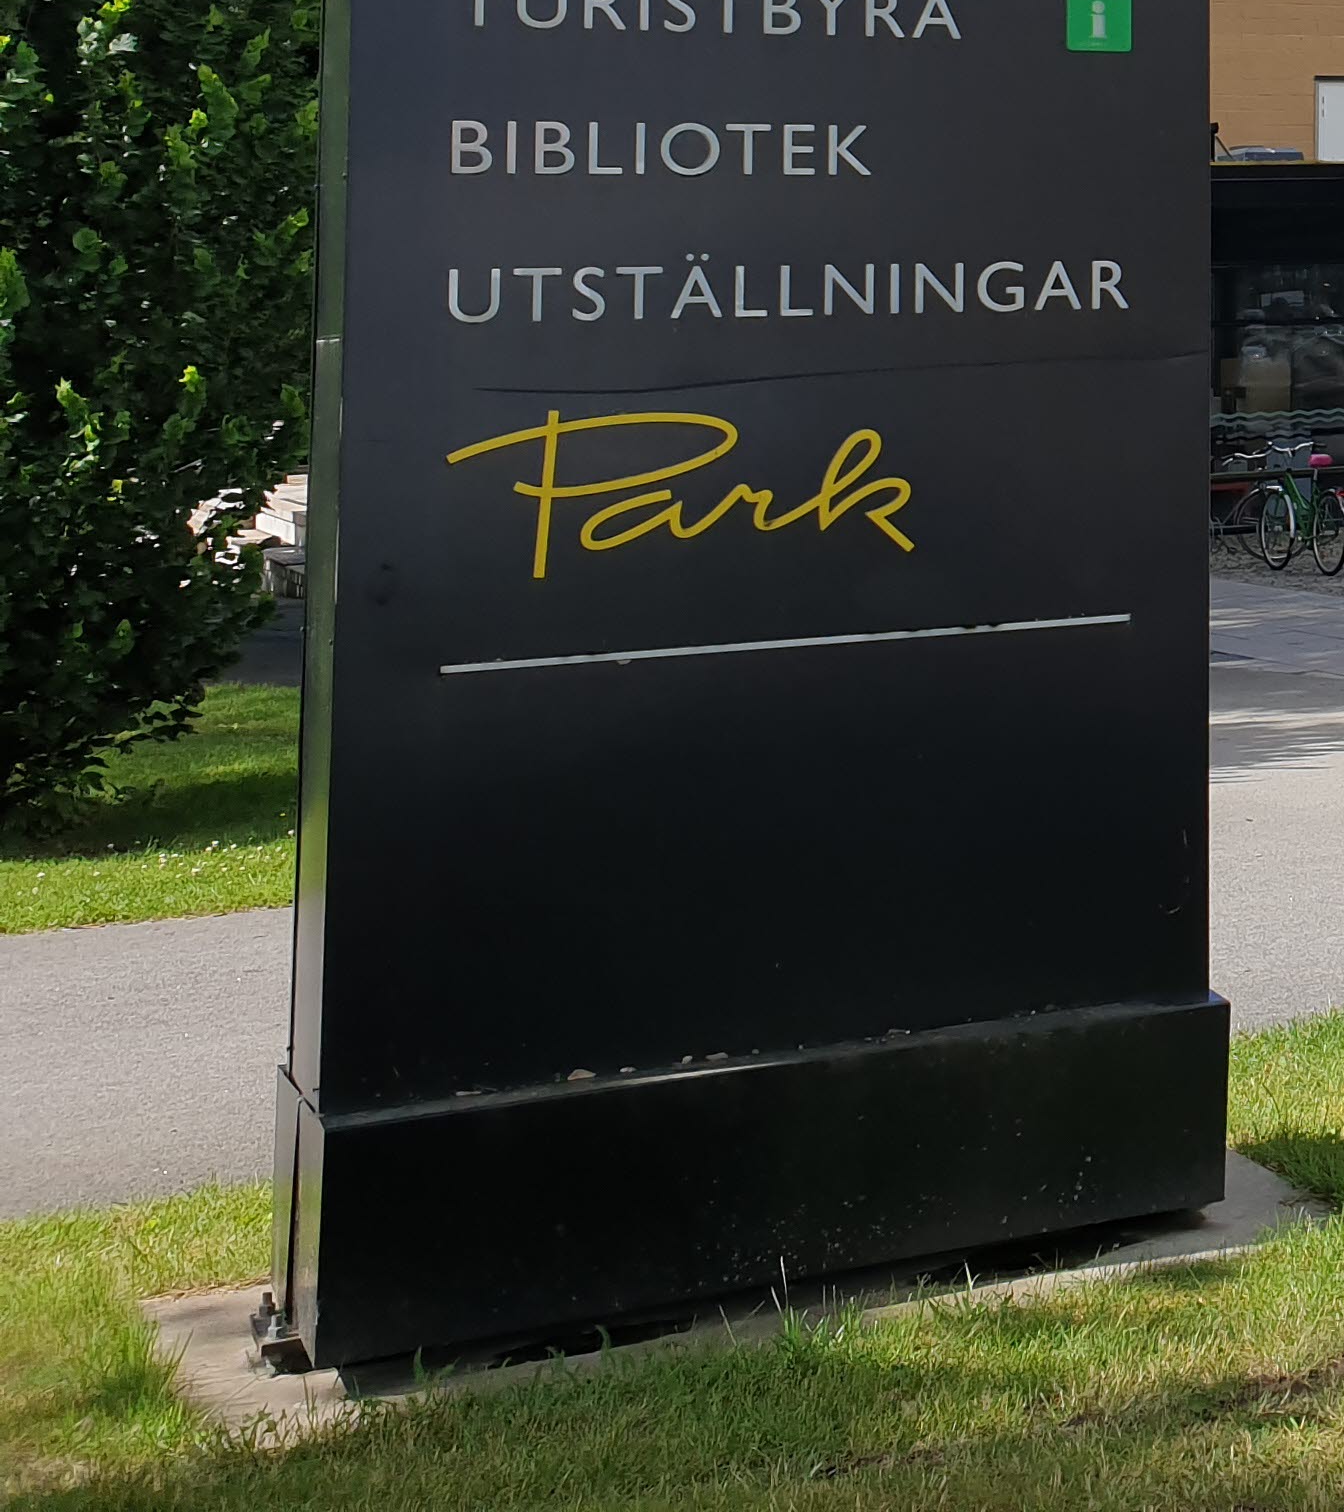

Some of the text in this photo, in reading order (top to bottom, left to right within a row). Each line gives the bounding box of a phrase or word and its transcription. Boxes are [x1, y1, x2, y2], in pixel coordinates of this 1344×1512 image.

[450, 120, 872, 177] BIBLIOTEK
[448, 254, 1130, 323] UTSTÄLLNINGAR
[446, 410, 915, 579] Park
